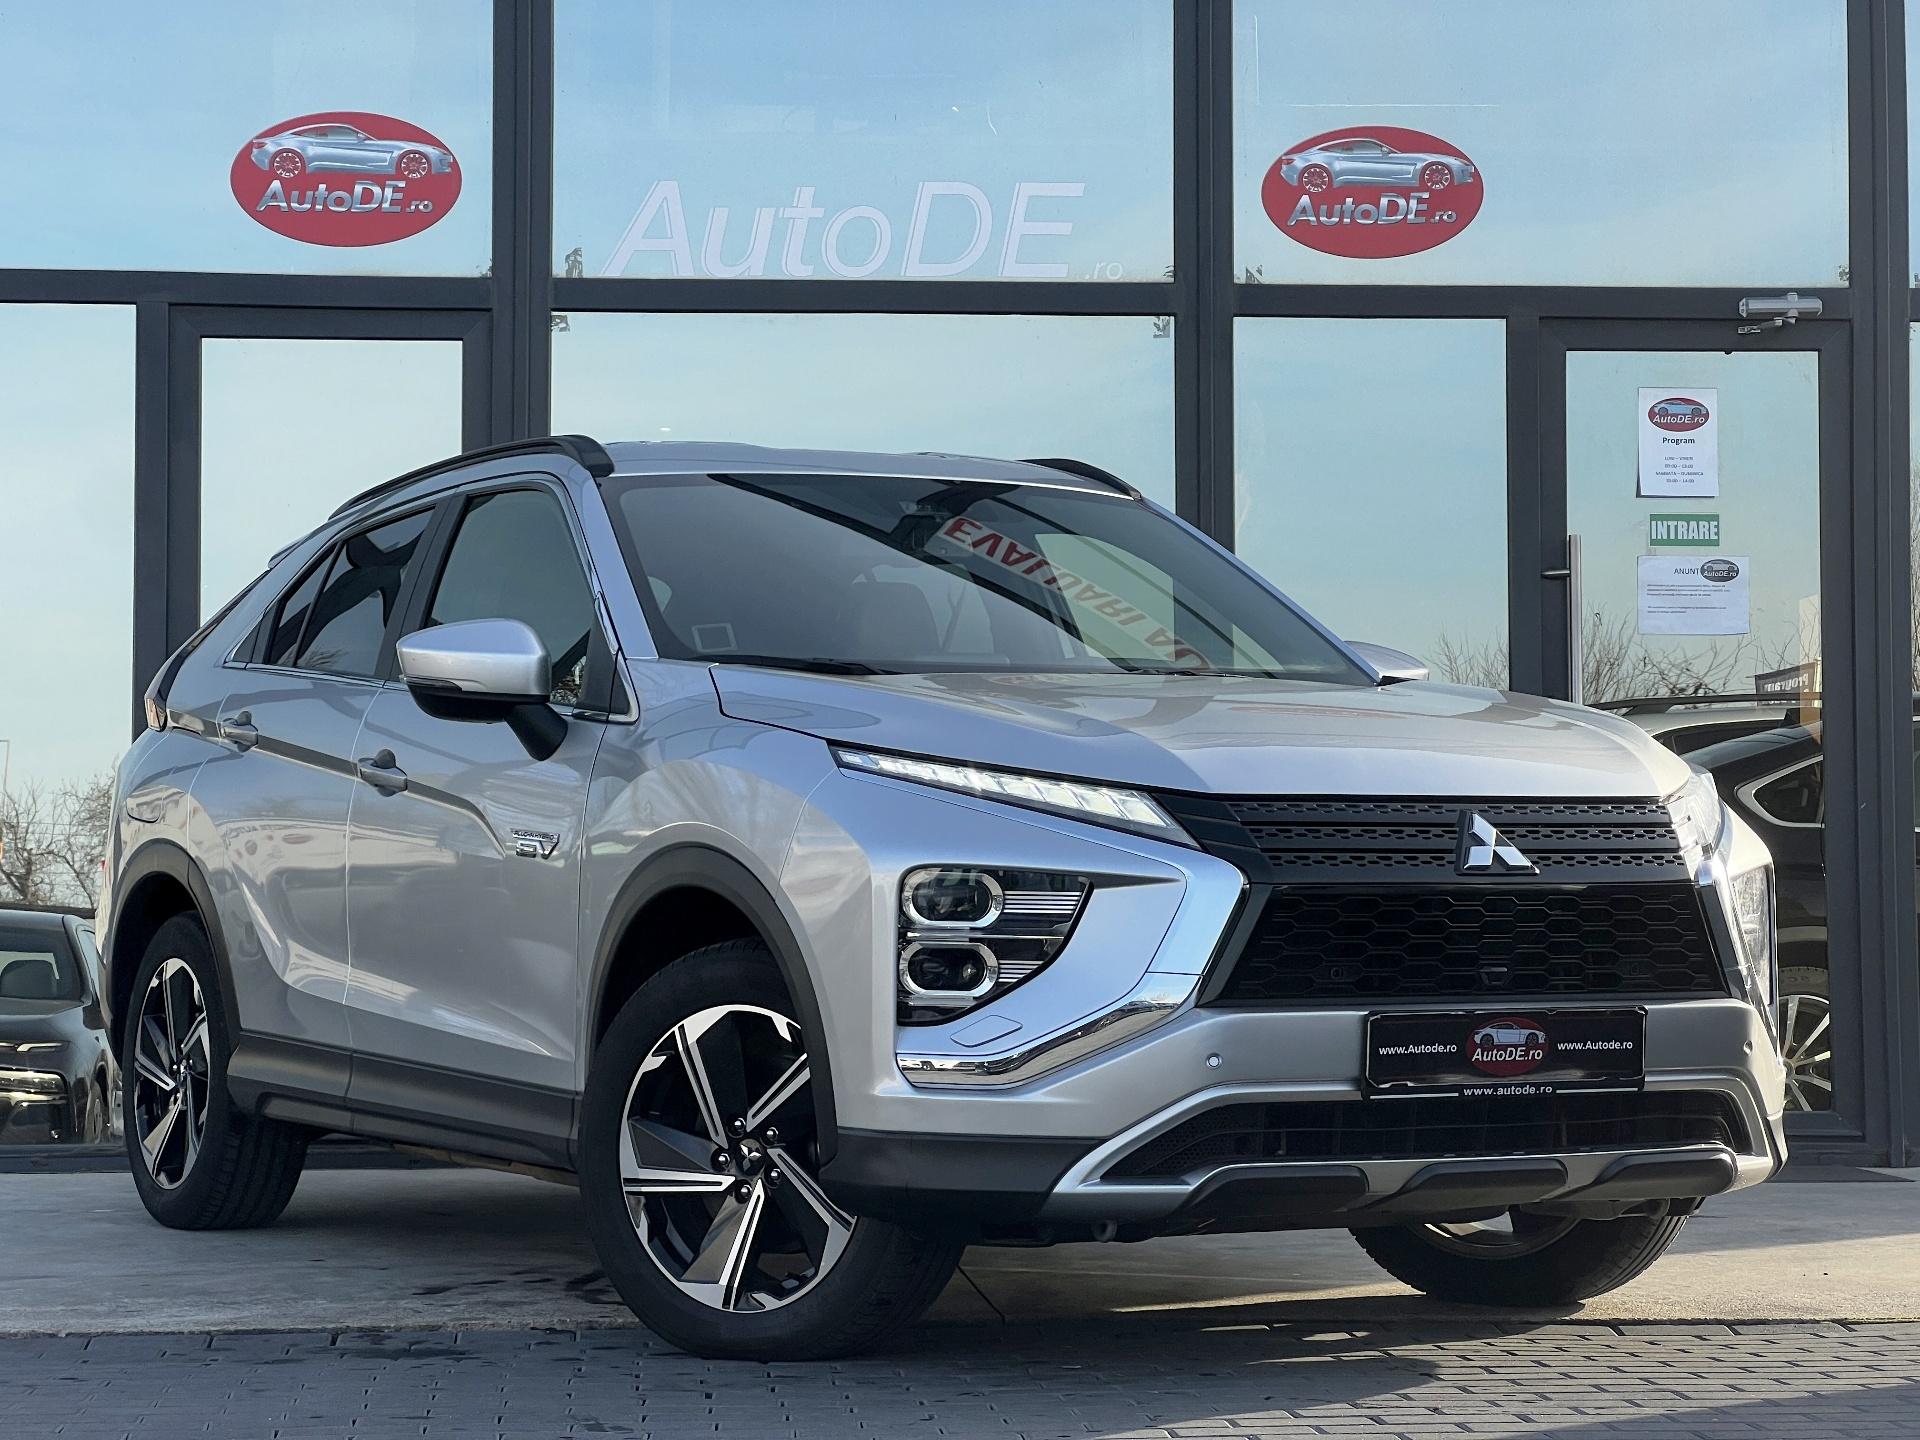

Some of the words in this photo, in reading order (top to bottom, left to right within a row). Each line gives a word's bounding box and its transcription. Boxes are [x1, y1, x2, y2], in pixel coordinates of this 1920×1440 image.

[1652, 415, 1705, 424] AutoDE.ro
[1662, 437, 1696, 446] Program
[1651, 520, 1719, 540] INTRARE
[1379, 1042, 1457, 1055] www.Autode.ro
[1557, 1039, 1634, 1051] www.Autode.ro
[1472, 1047, 1544, 1062] AutoDE.ro
[1463, 1084, 1553, 1097] www.autode.ro
